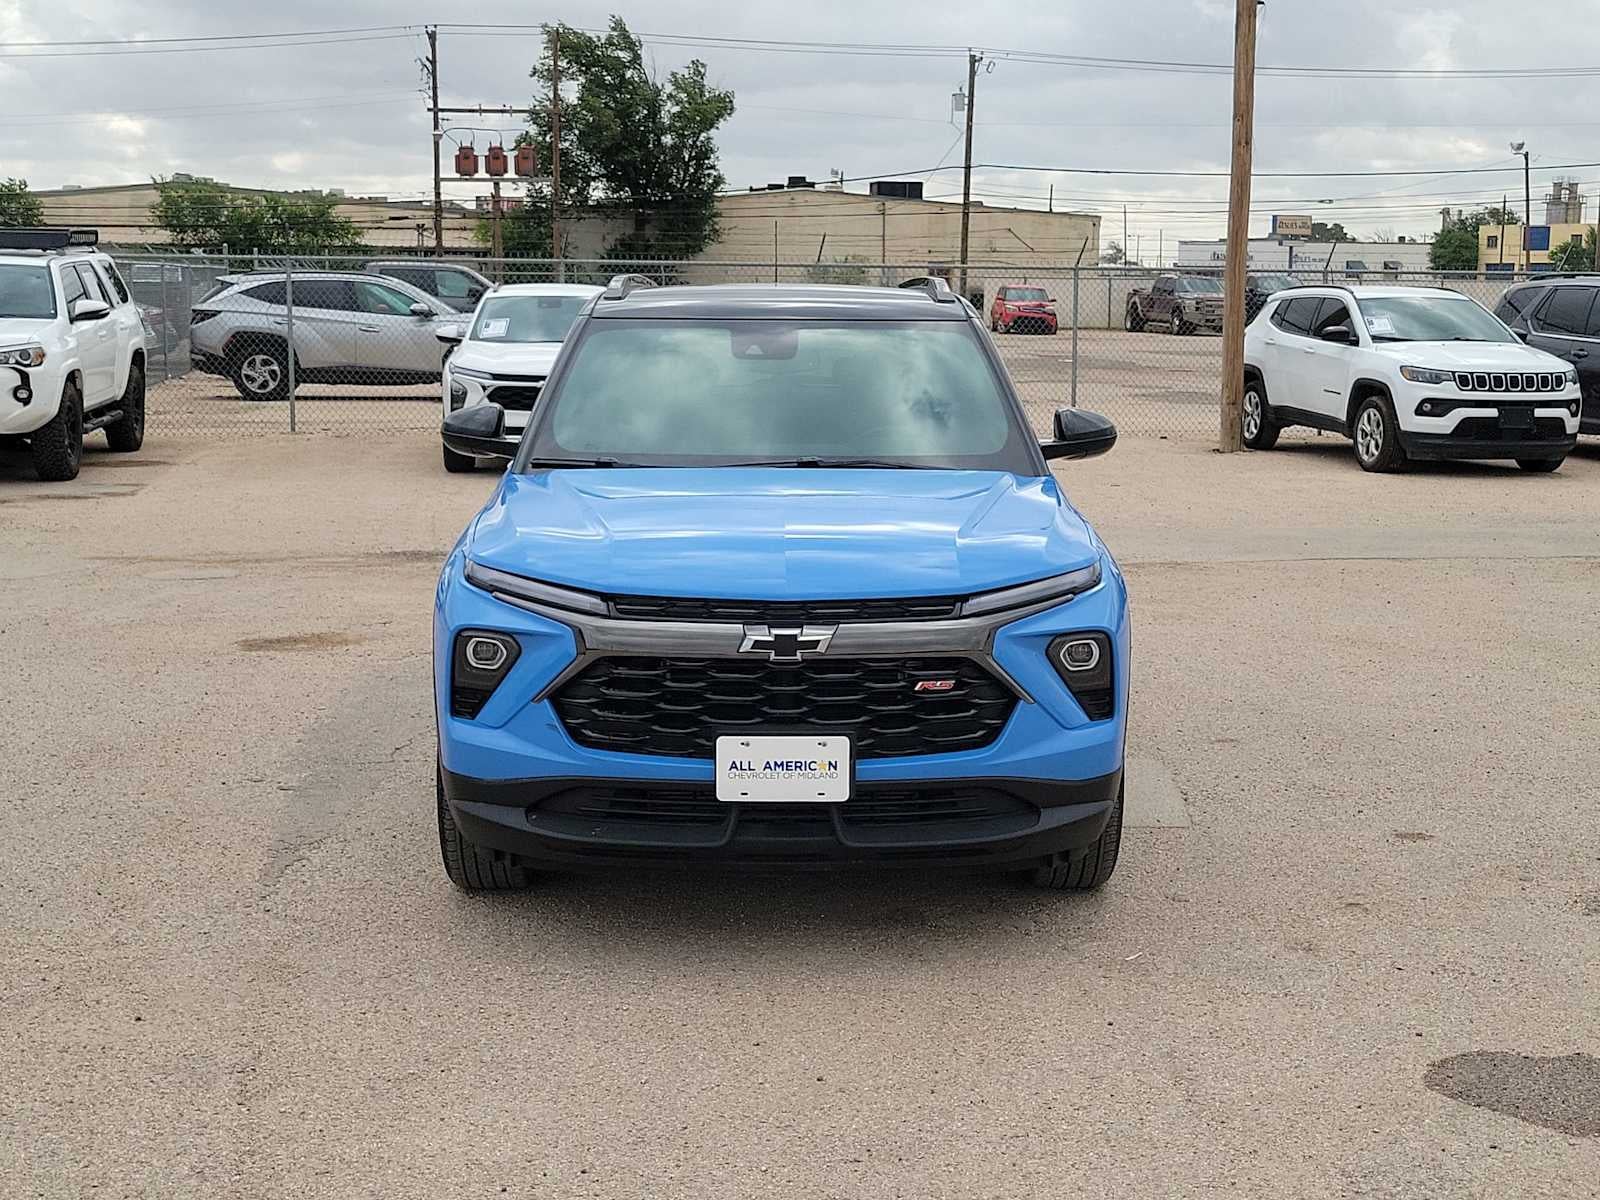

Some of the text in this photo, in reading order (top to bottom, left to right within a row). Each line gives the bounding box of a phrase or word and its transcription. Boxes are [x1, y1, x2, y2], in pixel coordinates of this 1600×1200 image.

[914, 680, 956, 691] RS
[728, 760, 756, 772] ALL
[728, 771, 839, 780] CHEVROLET OF MIDLAND
